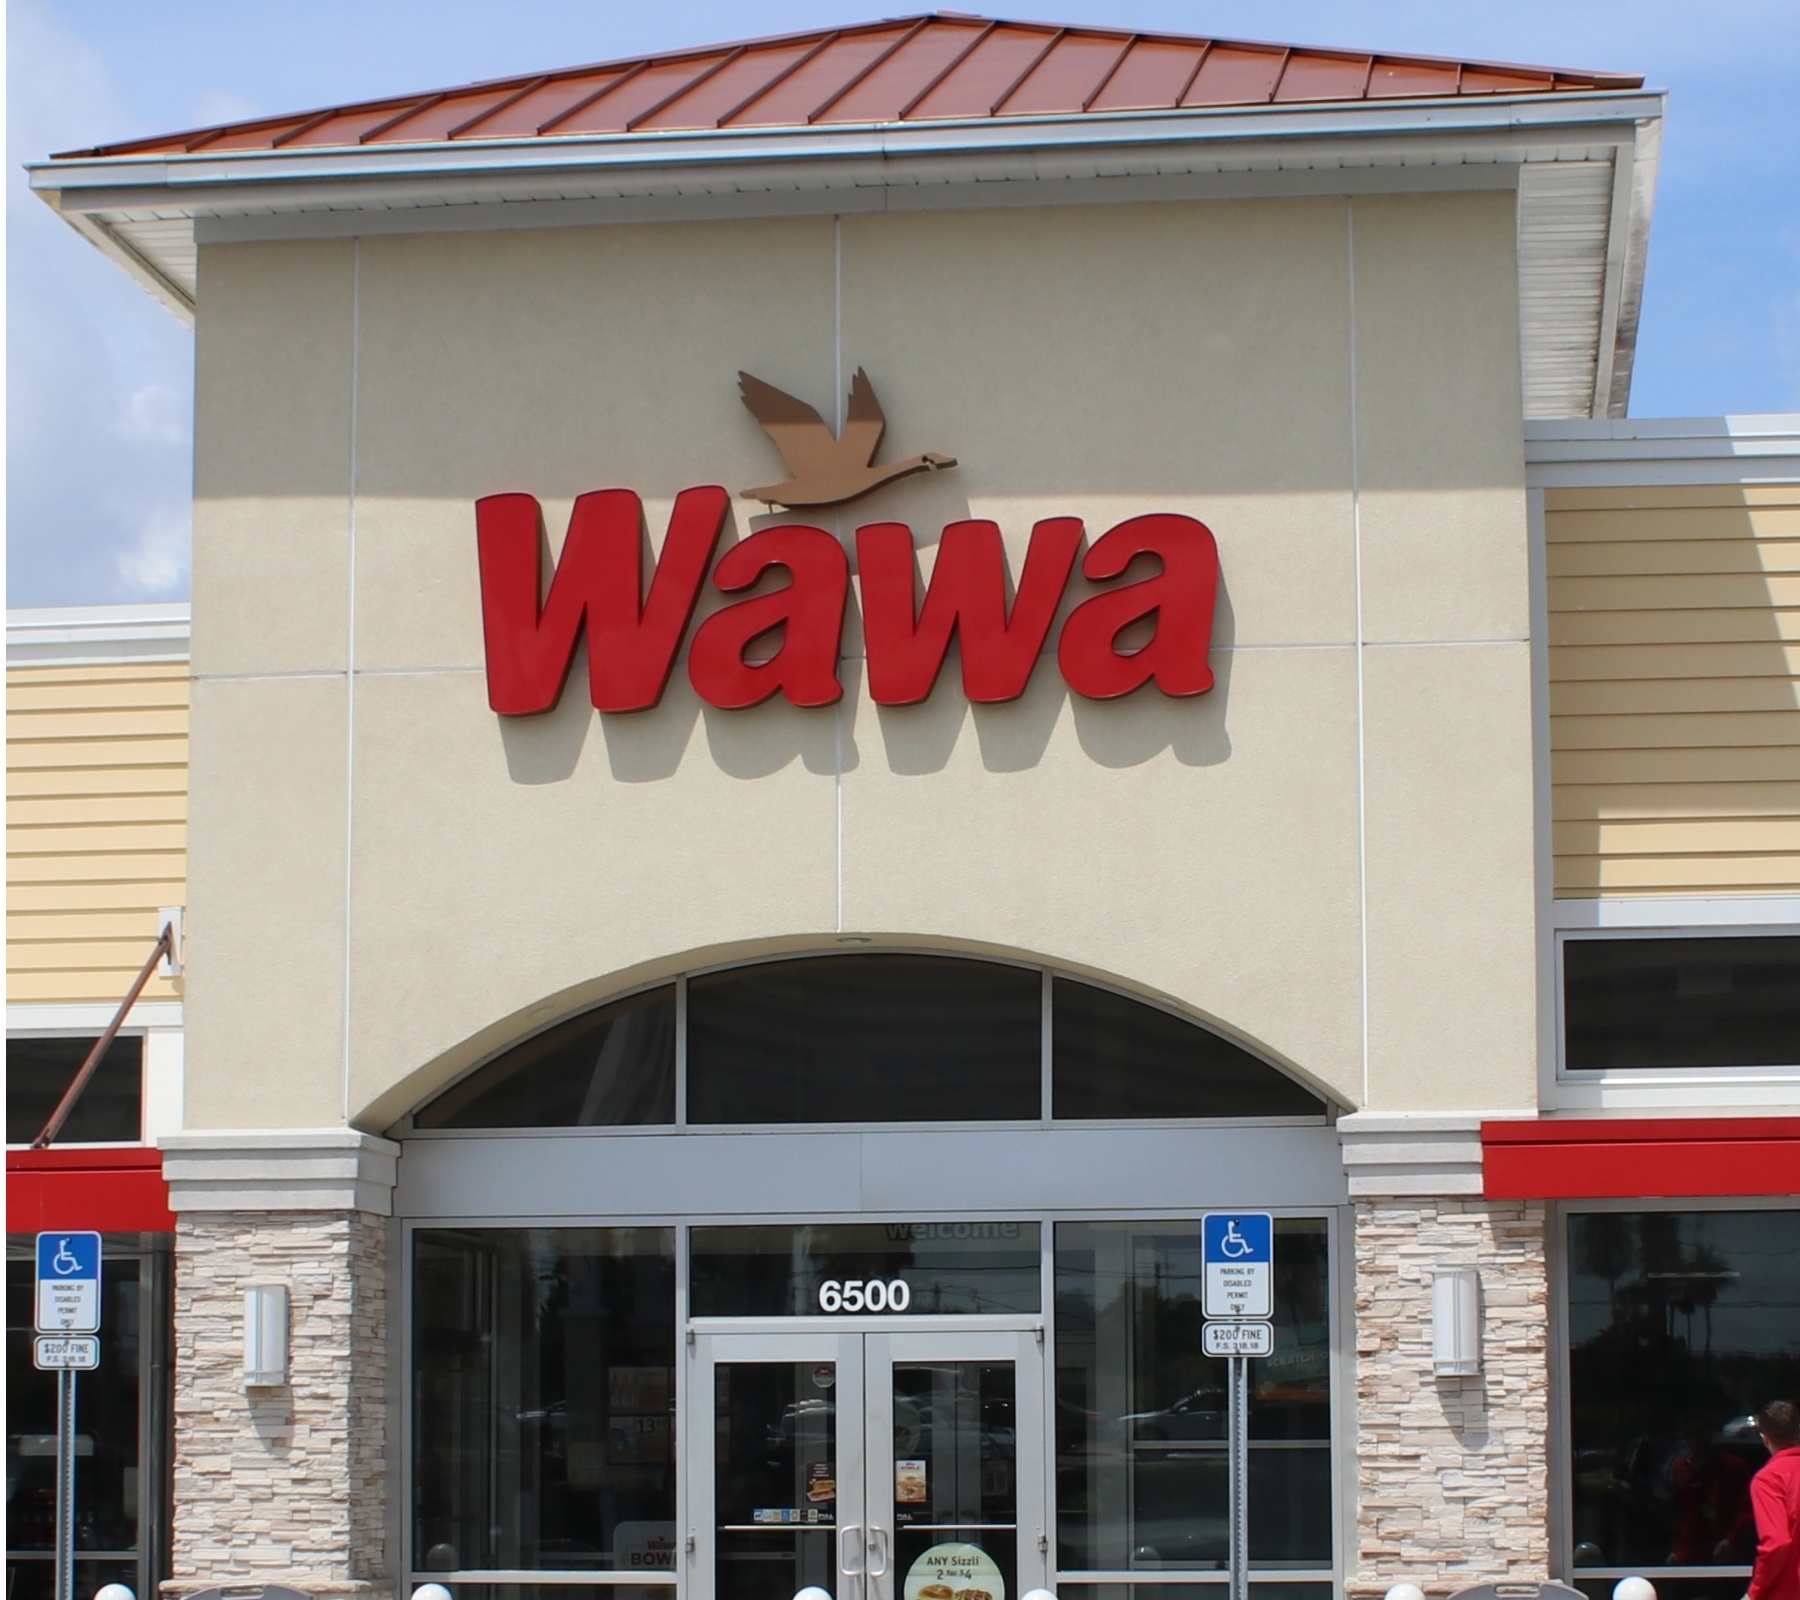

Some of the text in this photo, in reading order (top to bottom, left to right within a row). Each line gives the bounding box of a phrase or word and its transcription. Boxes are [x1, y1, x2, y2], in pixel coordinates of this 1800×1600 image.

[475, 484, 1220, 717] Wawa
[886, 1221, 1020, 1240] welcome
[1220, 1267, 1255, 1275] PARKING BY
[1223, 1279, 1253, 1287] DISABLED
[819, 1279, 910, 1312] 6500
[1226, 1291, 1249, 1299] PERMIT
[1213, 1329, 1262, 1340] $200 FINE
[44, 1343, 90, 1354] $200 FINE
[926, 1555, 979, 1567] ANY Sizzli
[936, 1569, 944, 1580] 2
[960, 1568, 972, 1580] $4
